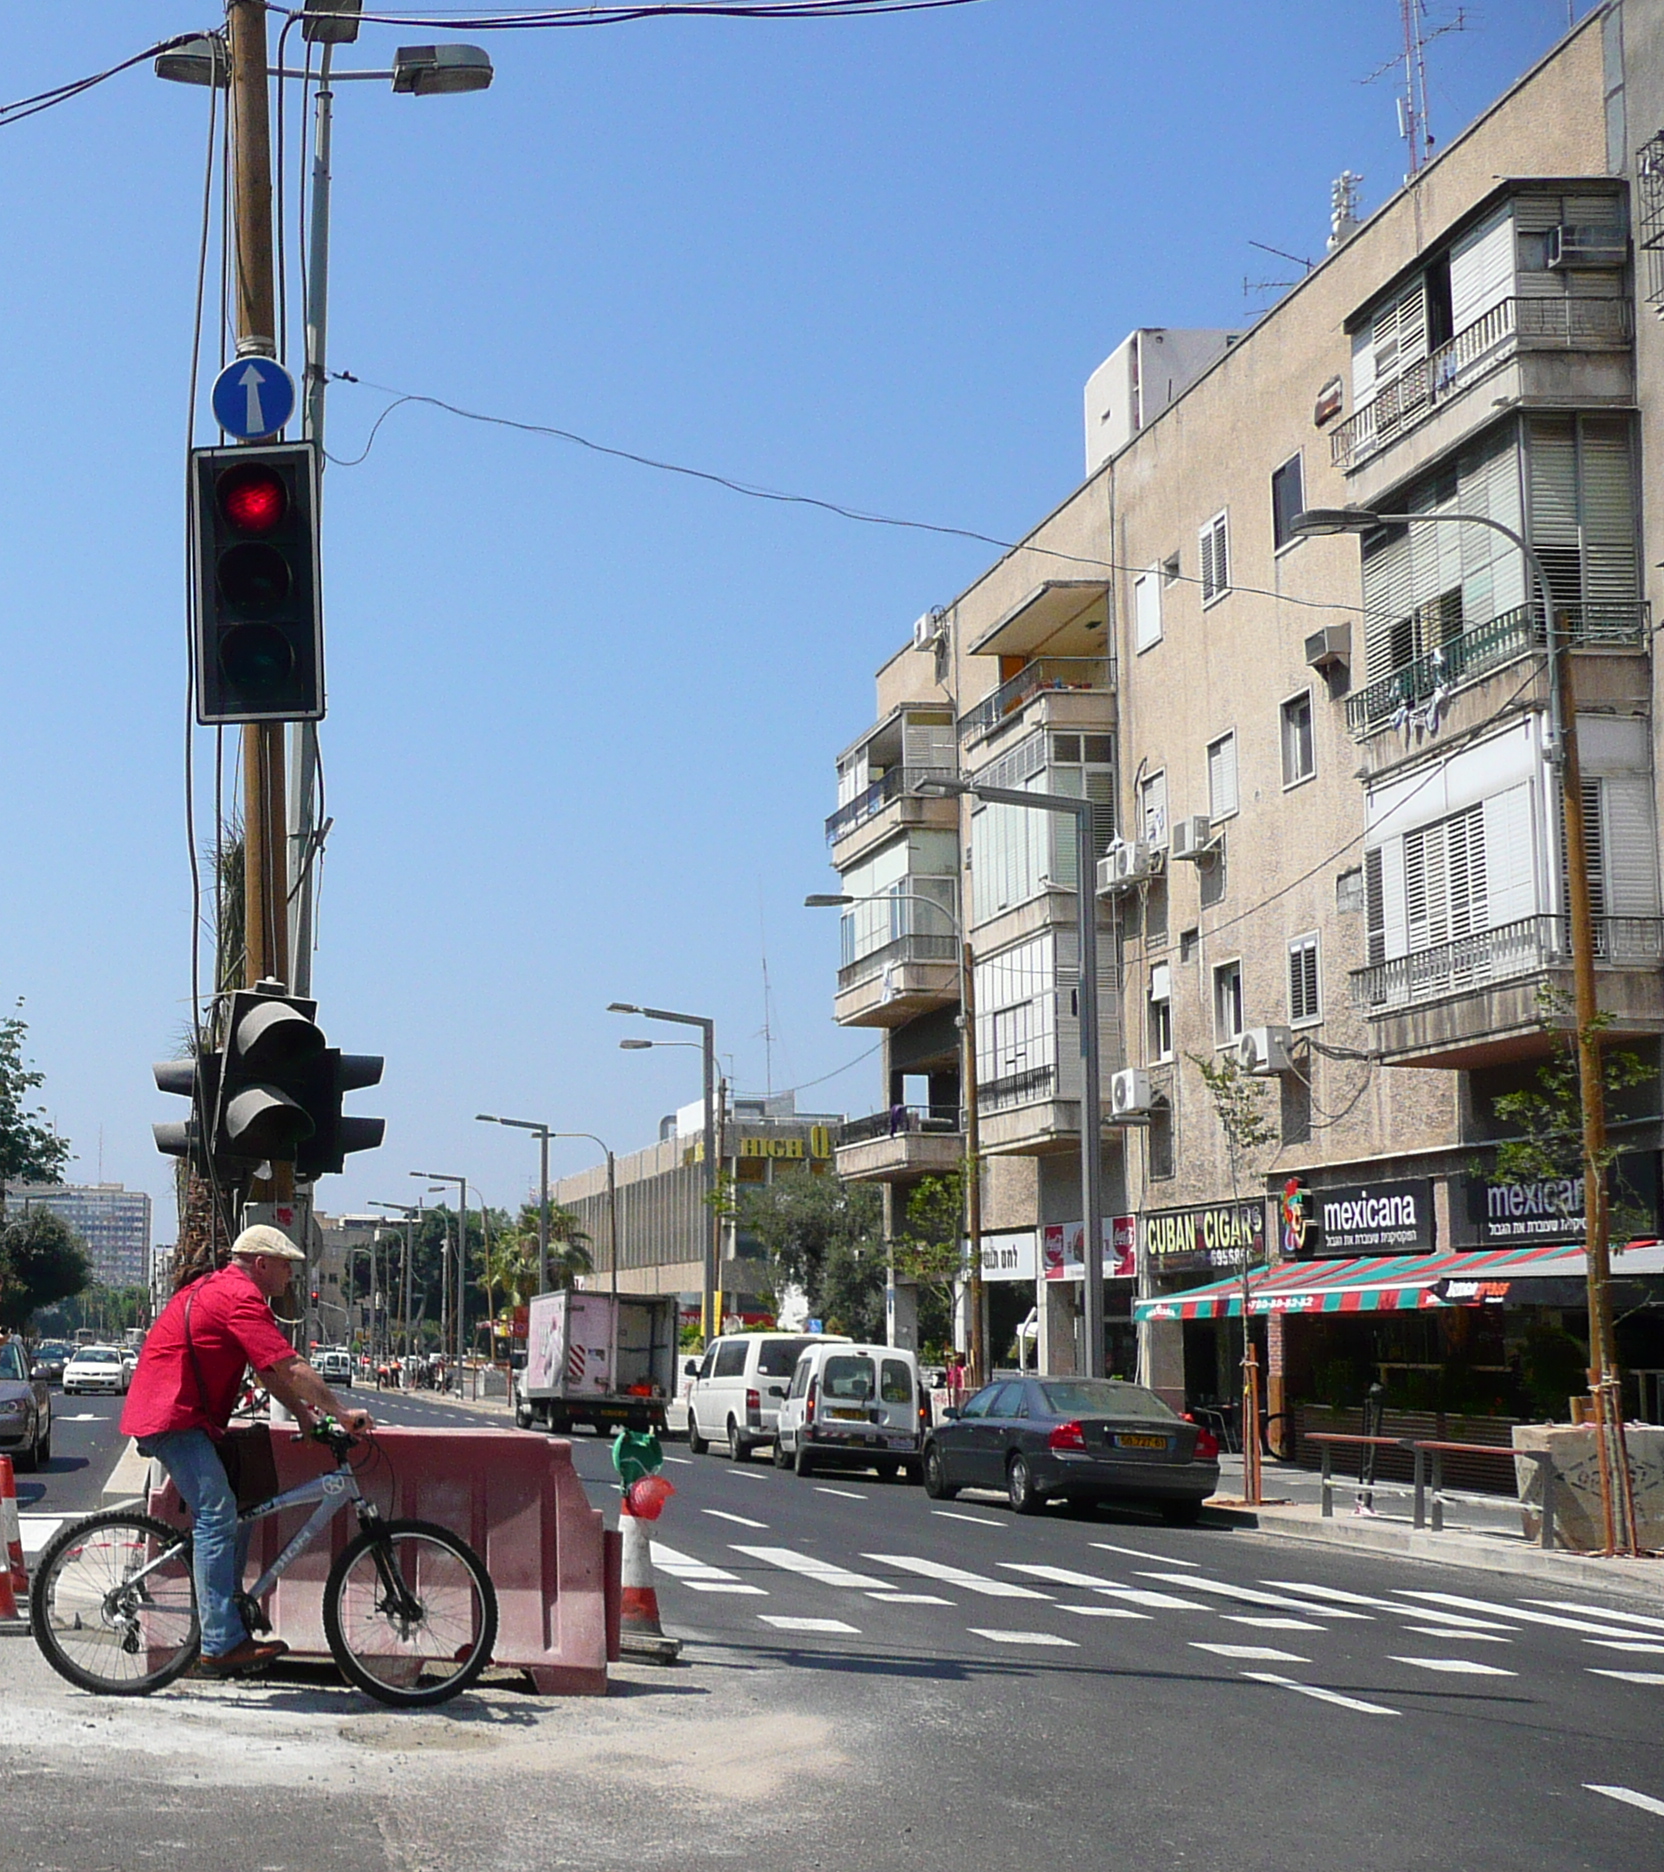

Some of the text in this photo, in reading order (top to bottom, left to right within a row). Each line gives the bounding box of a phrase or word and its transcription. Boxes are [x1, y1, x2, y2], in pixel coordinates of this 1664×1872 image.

[740, 1125, 832, 1159] HIGH Q
[1324, 1190, 1417, 1231] mexicana
[1487, 1177, 1587, 1218] mexican
[1147, 1205, 1263, 1255] CUBAN CIGARS
[1344, 1234, 1354, 1246] את
[1512, 1221, 1526, 1234] את
[1001, 1243, 1018, 1270] לחם
